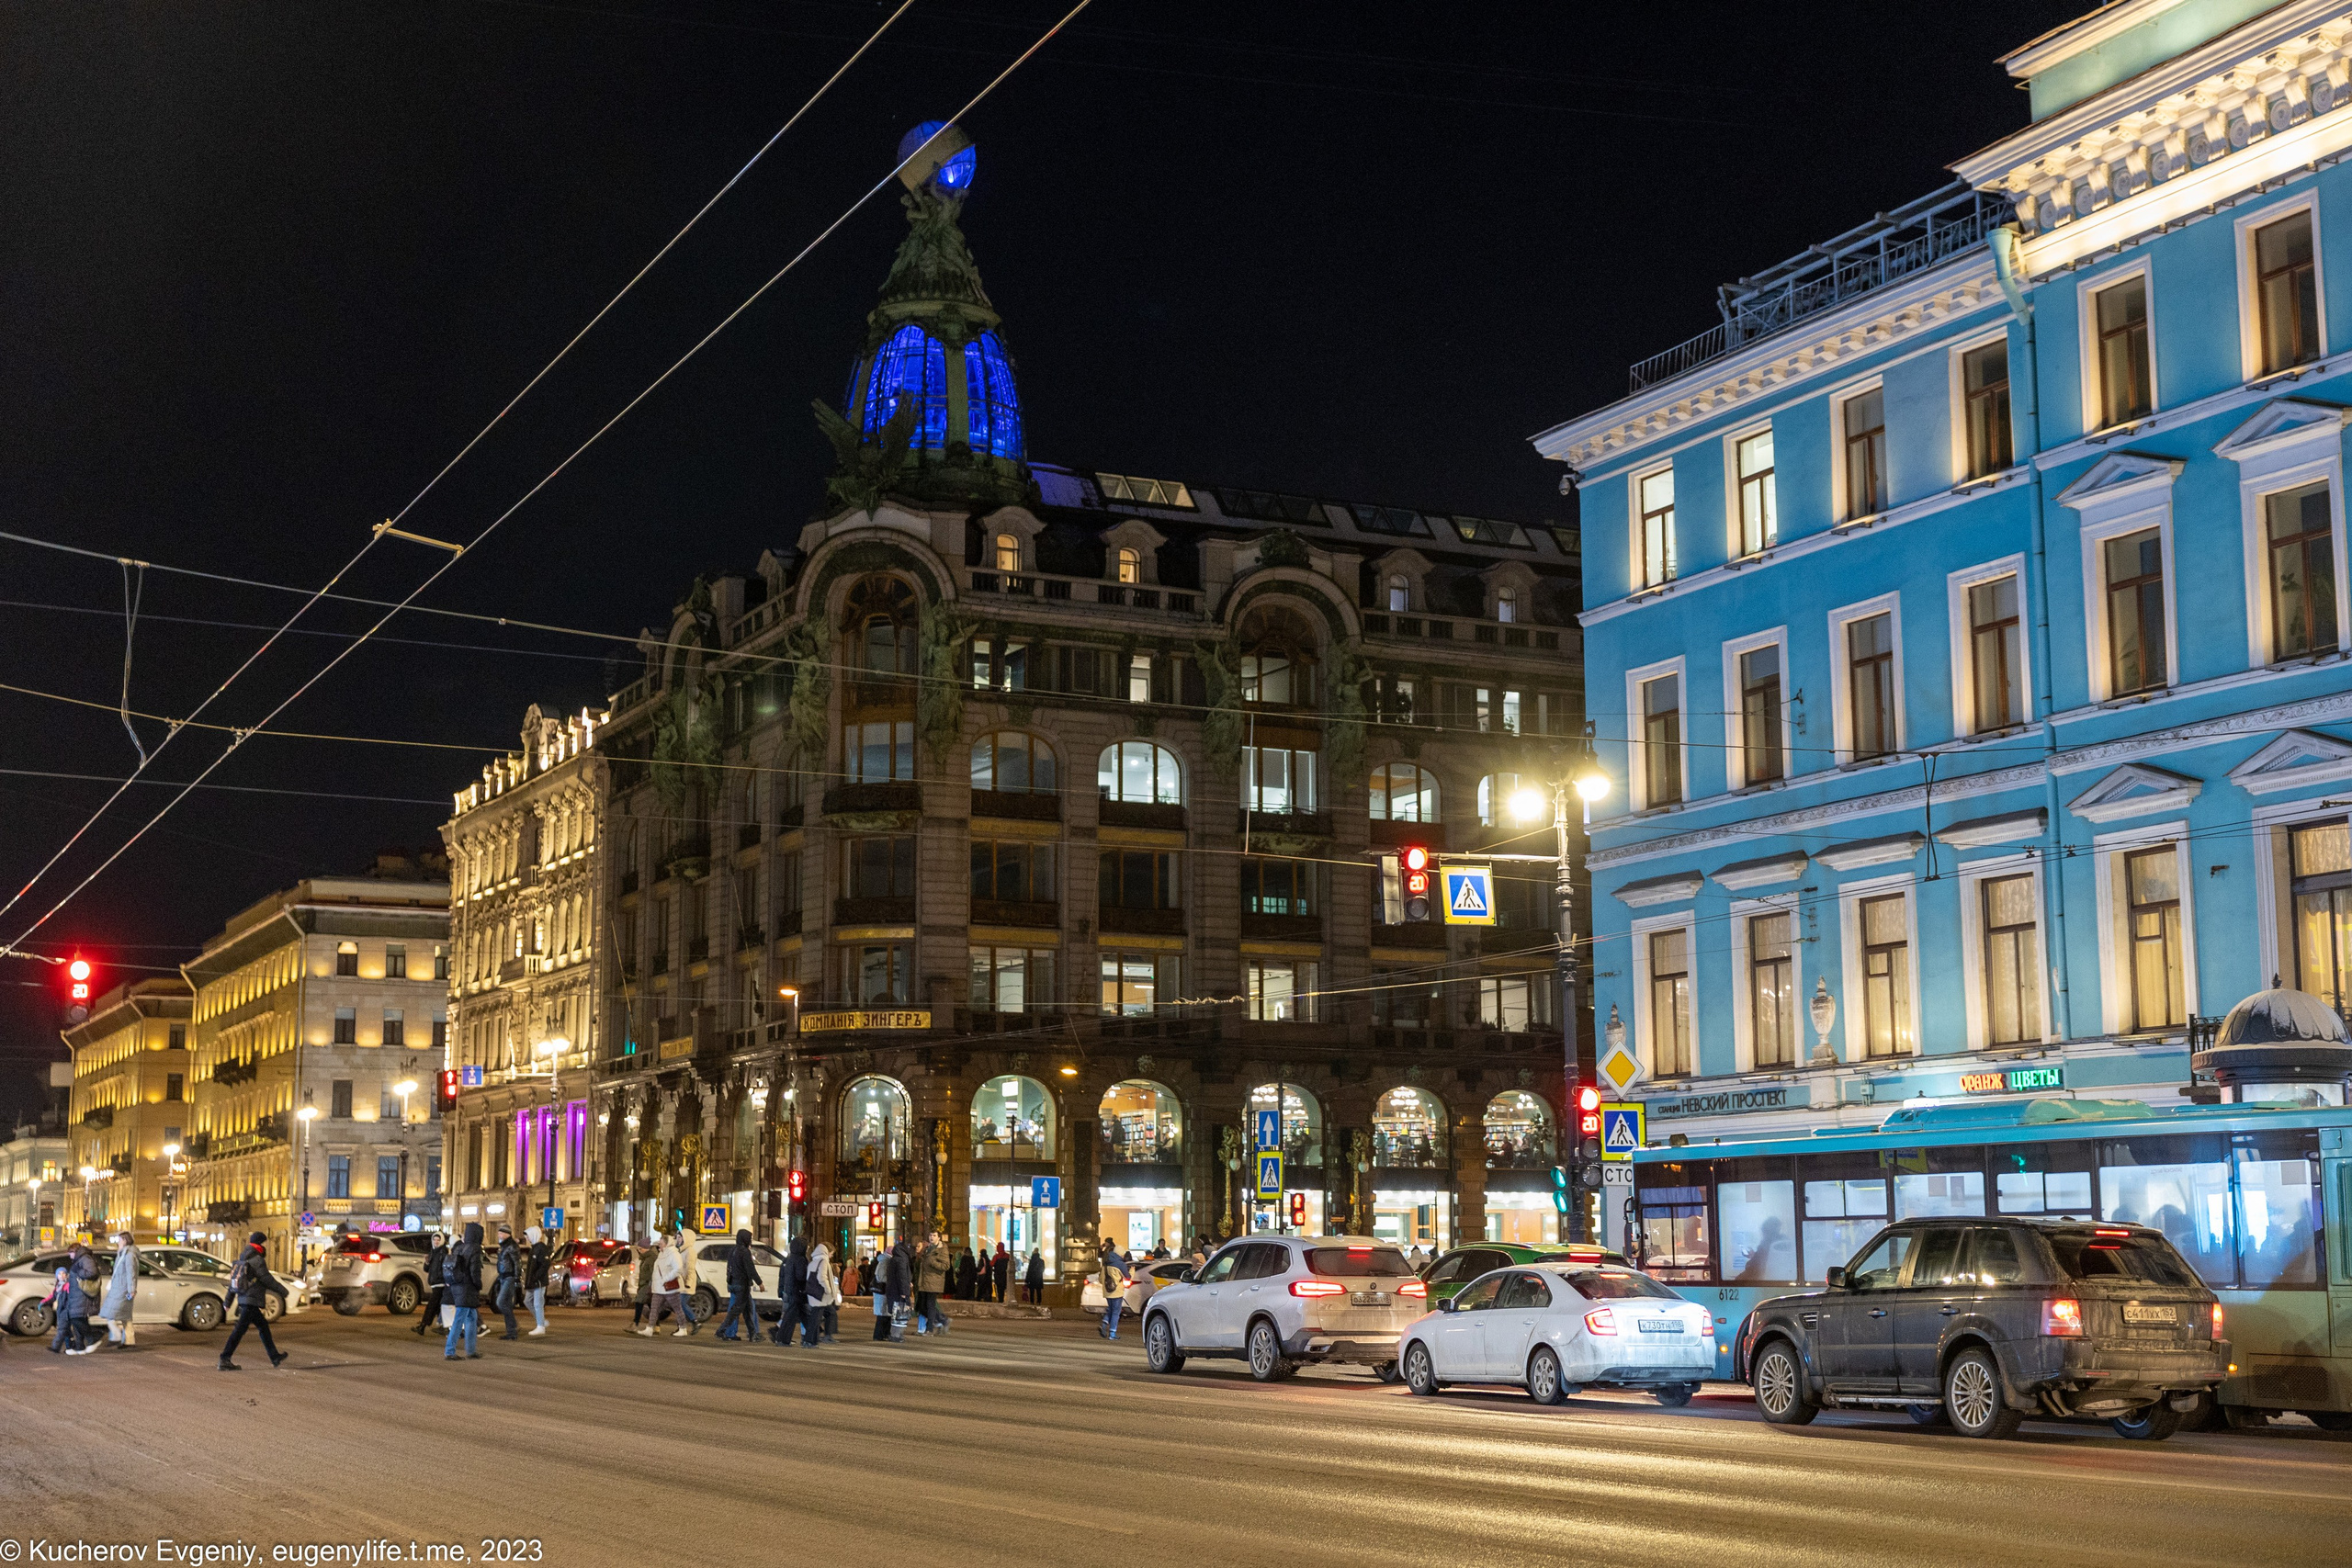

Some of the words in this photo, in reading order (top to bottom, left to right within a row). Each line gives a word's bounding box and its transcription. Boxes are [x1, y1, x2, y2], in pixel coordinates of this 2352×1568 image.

[804, 1013, 854, 1030] КОМПАНІЯ
[864, 1012, 922, 1027] ЗИНГЕРЪ
[1960, 1073, 2003, 1091] ОРАНЖ
[2010, 1068, 2061, 1091] ЦВЕТЫ
[1657, 1105, 1681, 1114] СТАНЦИЯ
[1681, 1091, 1729, 1113] НЕВСКИЙ
[1732, 1089, 1788, 1109] ПРОСПЕКТ
[1582, 1116, 1598, 1132] 20
[1604, 1168, 1633, 1183] СТО
[826, 1204, 854, 1215] СТОП
[1719, 1288, 1739, 1301] 6122
